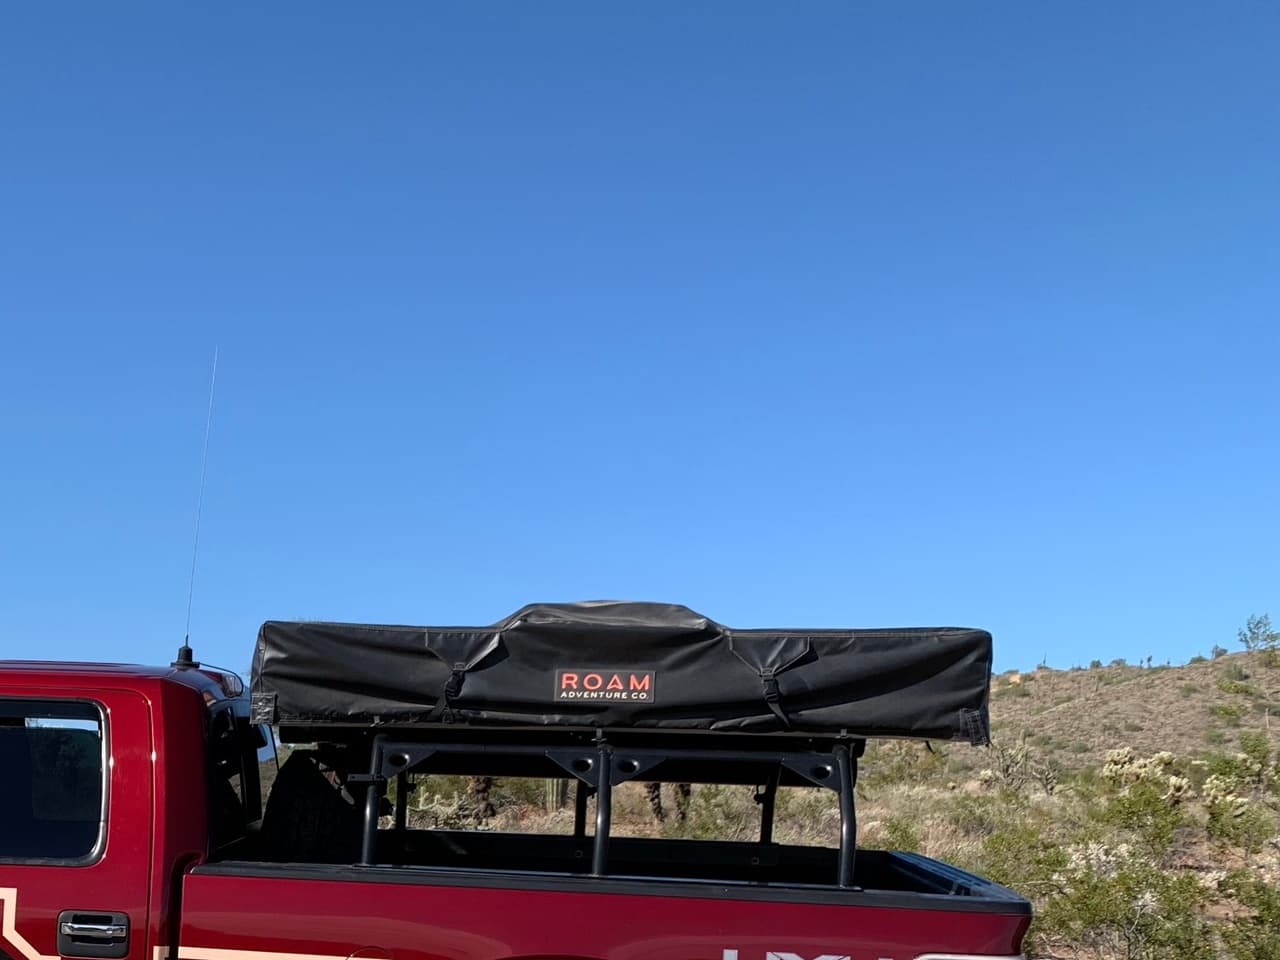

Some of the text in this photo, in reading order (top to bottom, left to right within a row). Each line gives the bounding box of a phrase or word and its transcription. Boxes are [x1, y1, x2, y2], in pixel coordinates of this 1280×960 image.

[561, 673, 650, 691] ROAM
[560, 691, 649, 700] ADVENTURE CO.
